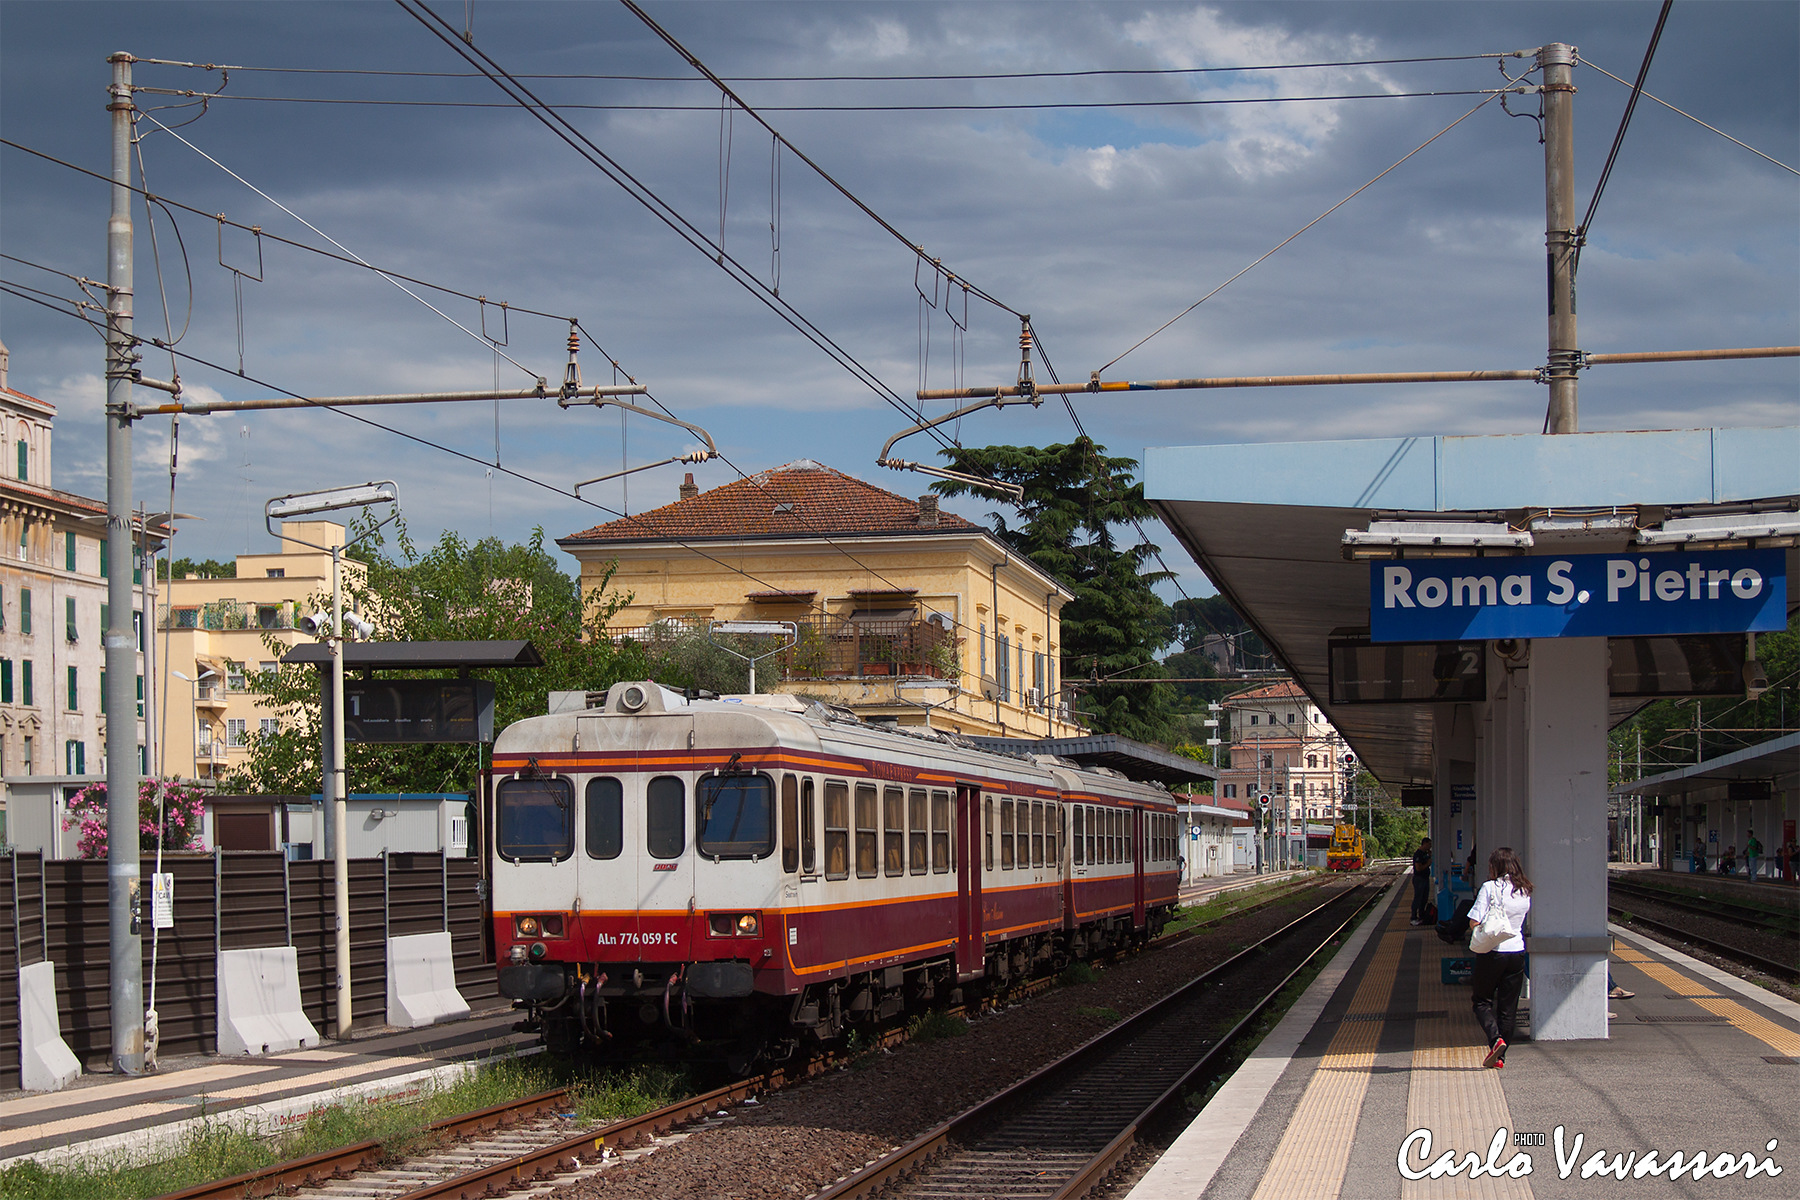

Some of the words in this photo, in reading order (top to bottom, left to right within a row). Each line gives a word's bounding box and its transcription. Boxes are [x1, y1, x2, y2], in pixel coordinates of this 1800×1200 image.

[1383, 566, 1532, 609] Roma
[1546, 560, 1591, 605] S.
[1607, 557, 1763, 603] Pietro
[1462, 652, 1479, 674] 2
[350, 695, 360, 716] 1
[597, 932, 617, 945] ALn
[619, 932, 639, 945] 776
[641, 932, 662, 945] 059
[665, 932, 678, 945] FC
